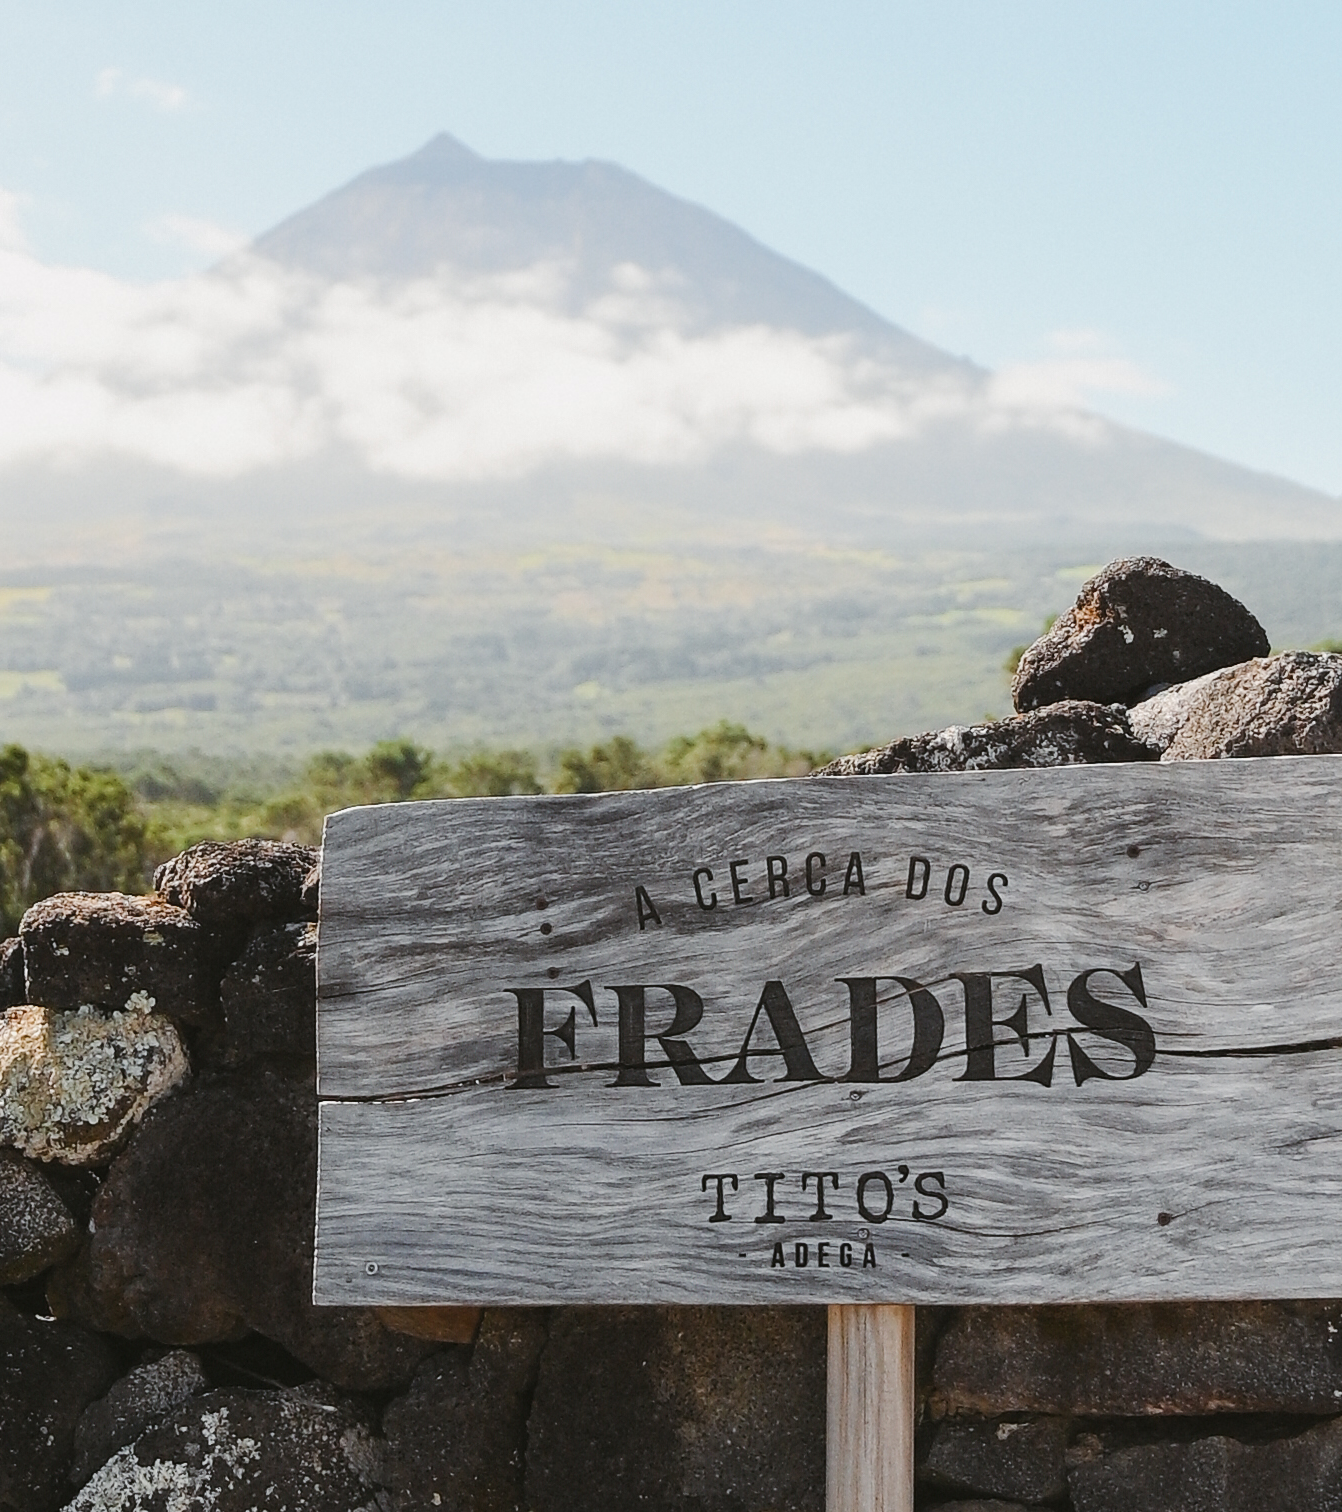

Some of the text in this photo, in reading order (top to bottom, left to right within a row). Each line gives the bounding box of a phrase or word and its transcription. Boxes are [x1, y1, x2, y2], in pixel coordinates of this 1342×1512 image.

[635, 851, 1010, 930] A CERCA DOS
[505, 961, 1157, 1089] FRADES
[701, 1164, 950, 1223] TITO'S
[771, 1241, 878, 1269] ADEGA
